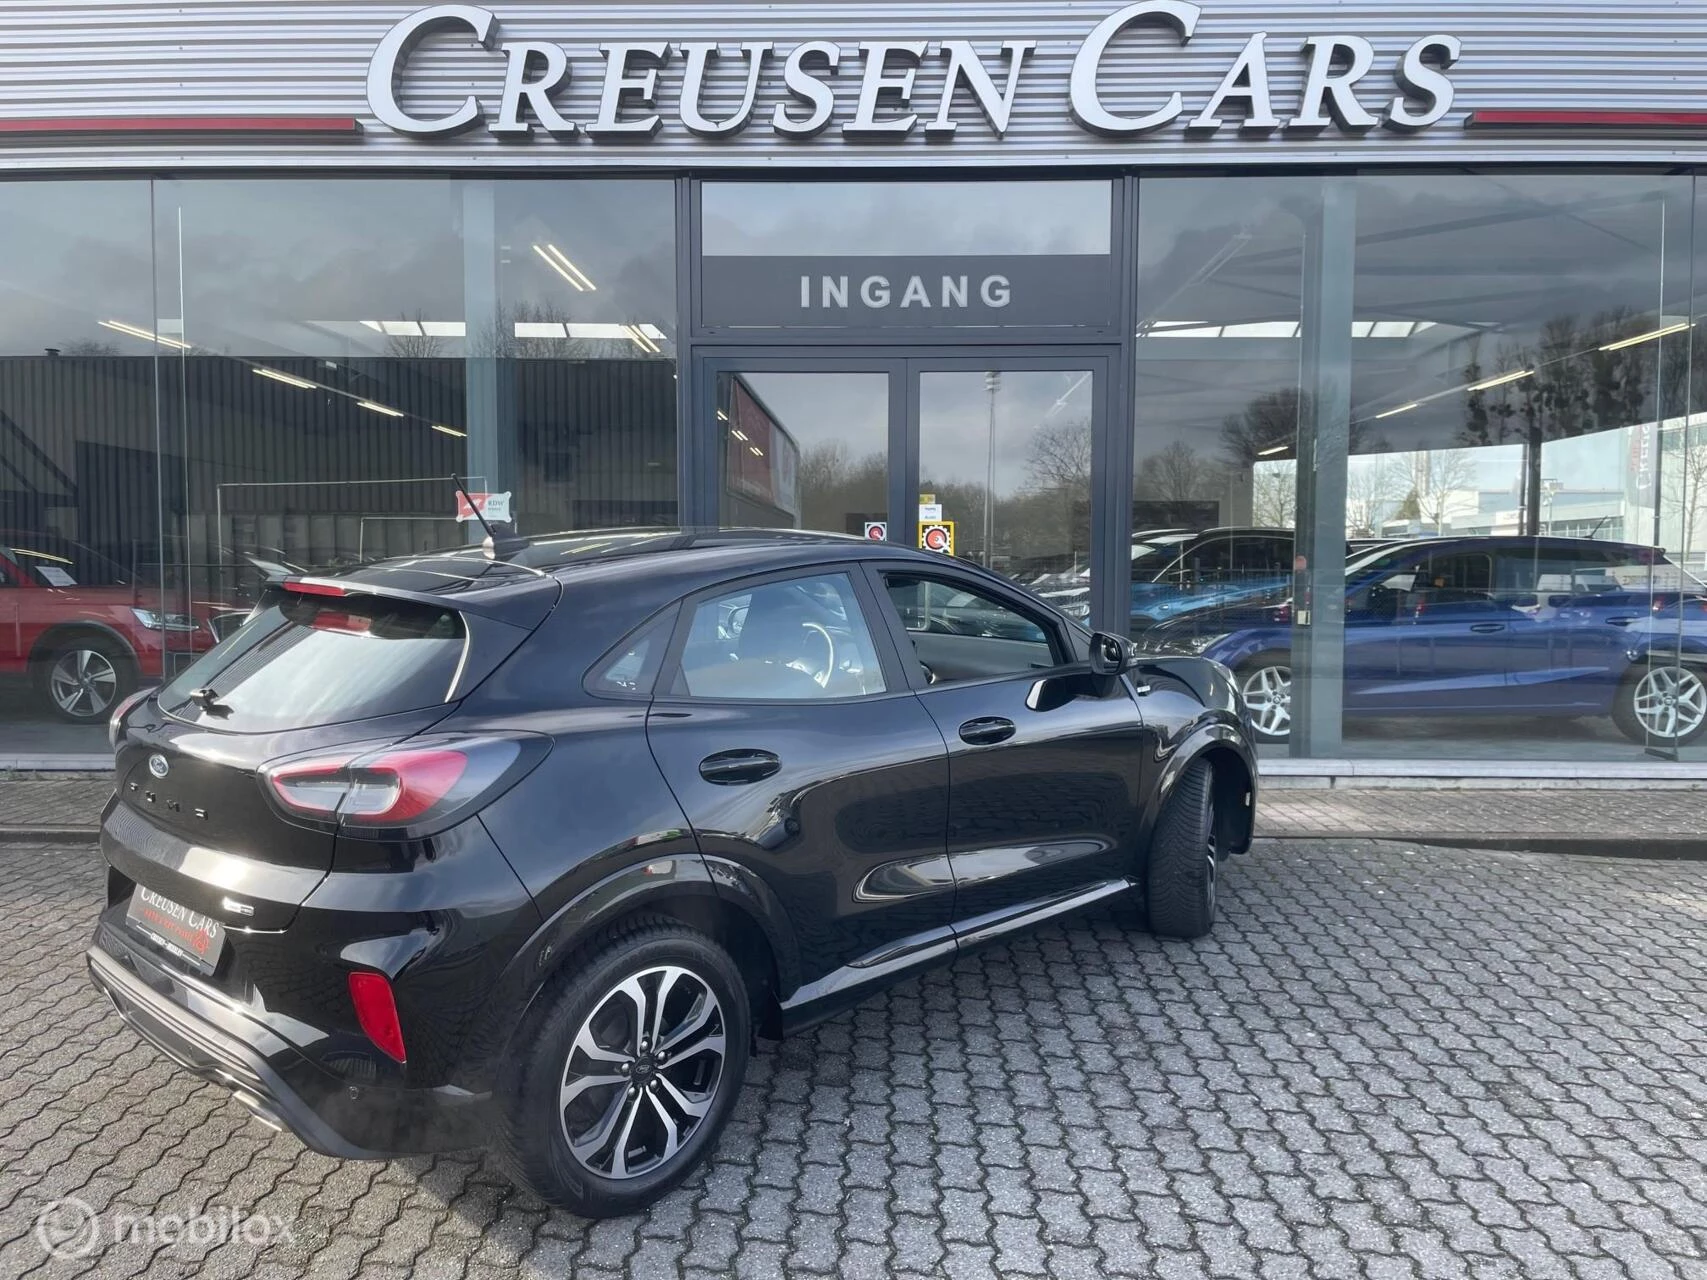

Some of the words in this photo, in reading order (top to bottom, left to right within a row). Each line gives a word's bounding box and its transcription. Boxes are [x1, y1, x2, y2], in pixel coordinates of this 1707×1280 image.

[365, 4, 1037, 139] CREUSEN
[1069, 0, 1461, 137] CARS
[800, 274, 1012, 309] INGANG
[188, 909, 220, 938] CARS
